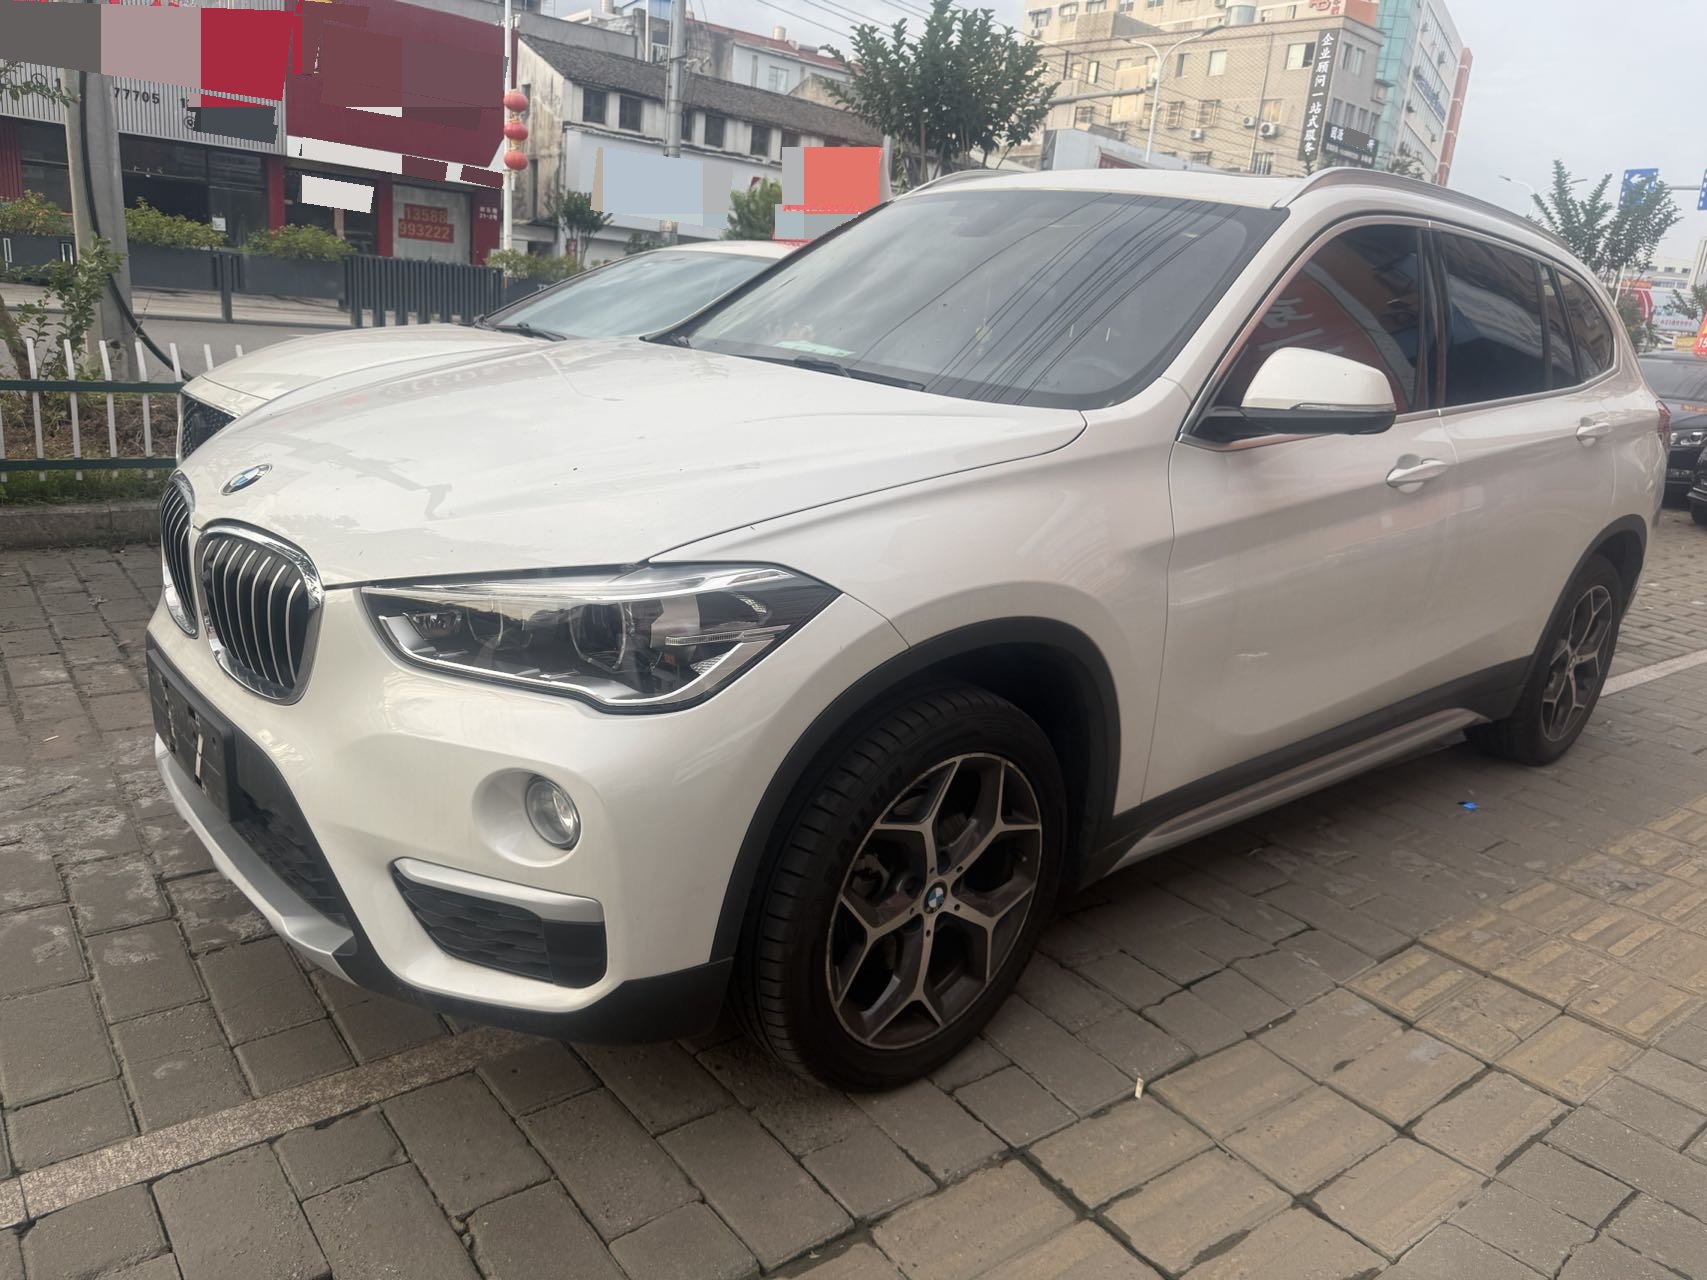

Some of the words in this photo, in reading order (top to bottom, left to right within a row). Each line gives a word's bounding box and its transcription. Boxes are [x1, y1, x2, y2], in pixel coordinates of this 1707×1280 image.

[1303, 32, 1335, 156] 企业顾问一站式服务
[400, 221, 450, 239] 993222
